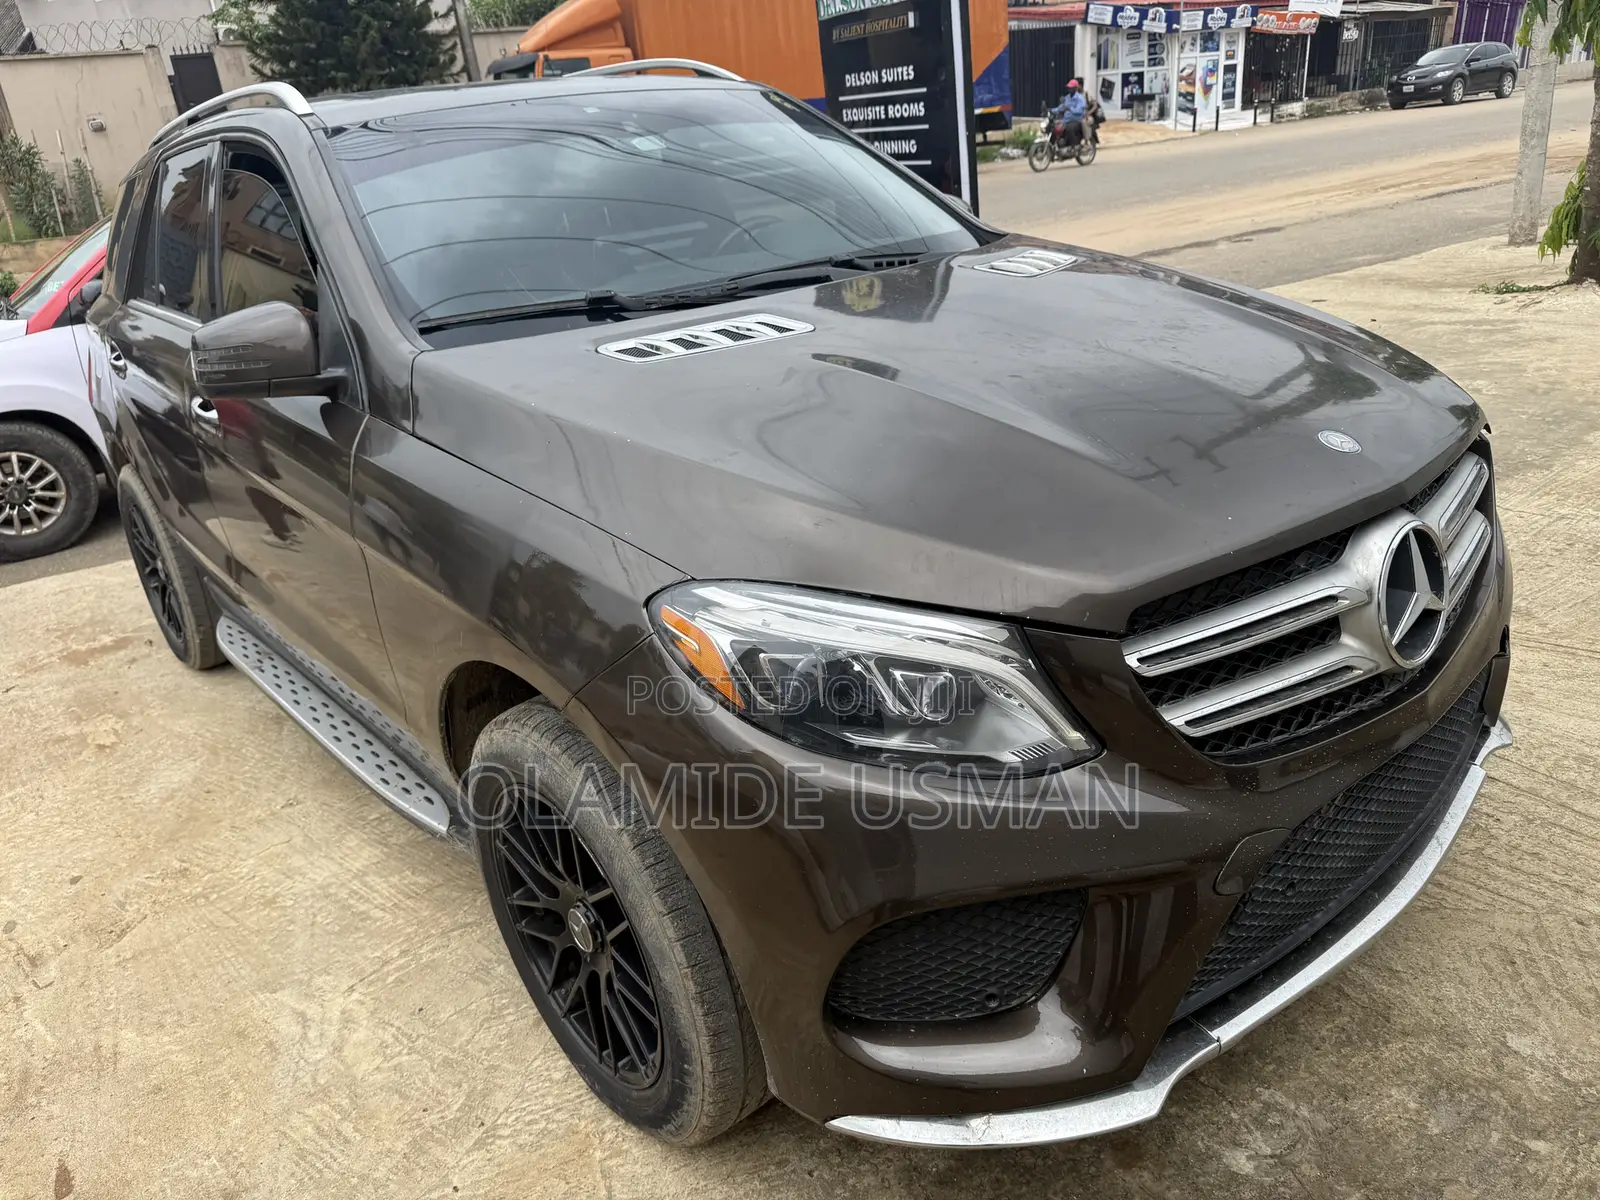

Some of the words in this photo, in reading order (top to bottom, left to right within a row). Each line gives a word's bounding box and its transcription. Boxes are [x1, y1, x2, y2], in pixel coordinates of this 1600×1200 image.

[840, 23, 865, 38] SALIENT
[866, 15, 908, 34] HOSPITALITY
[845, 70, 879, 87] DELSON
[881, 65, 915, 83] SUITES
[842, 105, 886, 122] EXQUISITE
[888, 101, 925, 119] ROOMS
